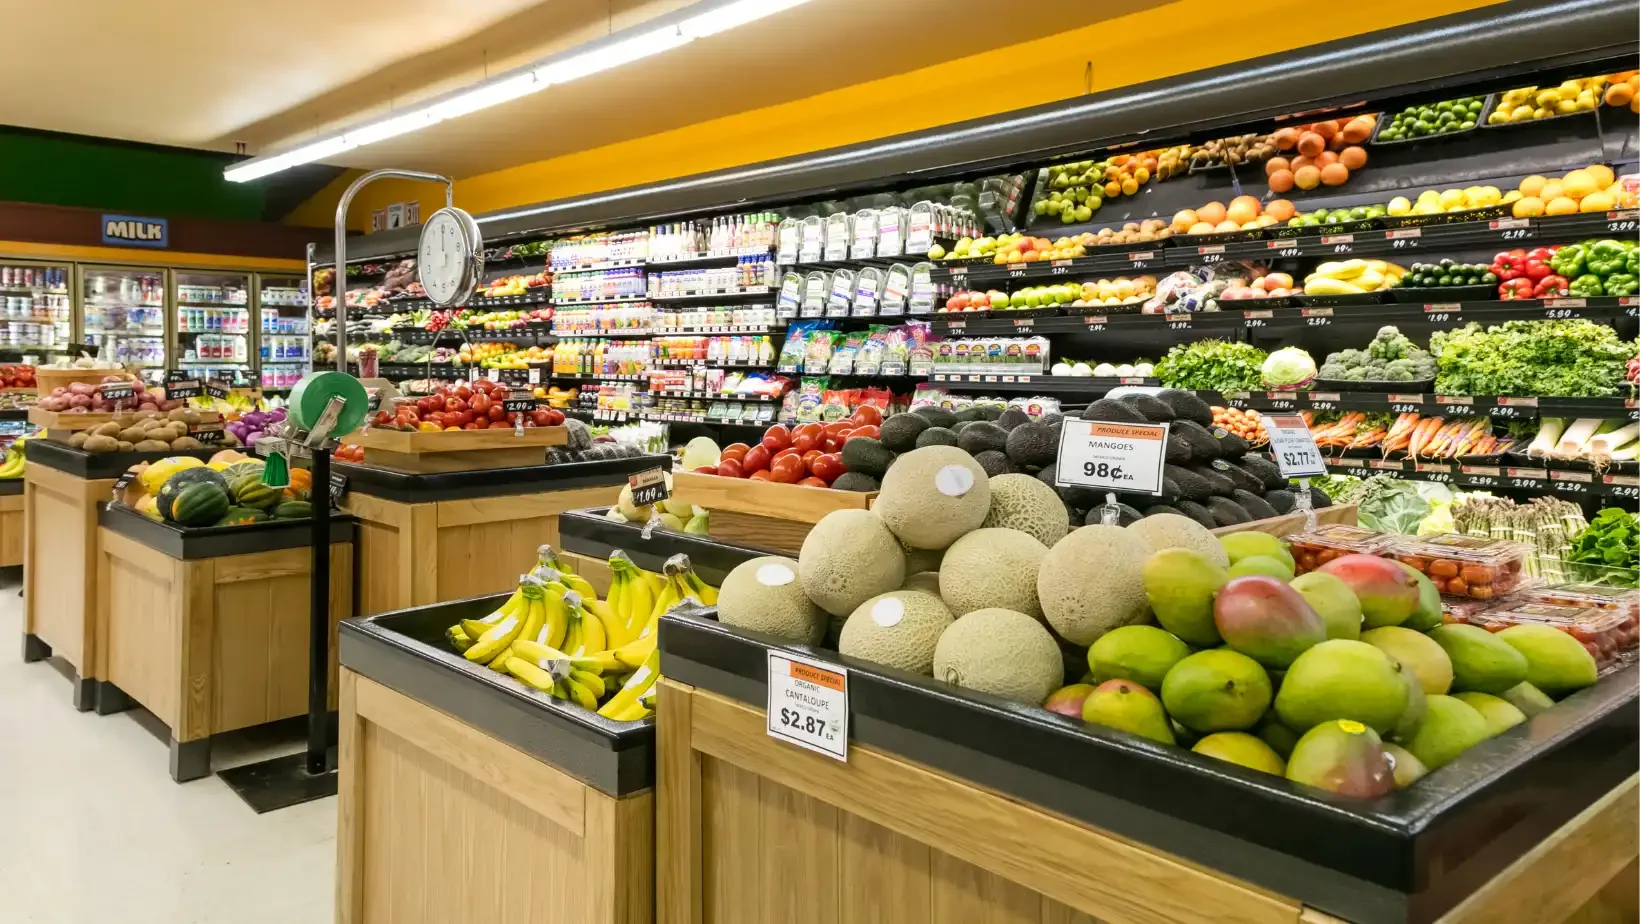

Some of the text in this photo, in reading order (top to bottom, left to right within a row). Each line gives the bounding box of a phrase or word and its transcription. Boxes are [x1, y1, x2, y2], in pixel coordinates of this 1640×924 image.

[106, 220, 162, 240] MILK
[1097, 427, 1129, 435] PRODUCE
[1088, 441, 1134, 451] MANGOES
[1283, 451, 1309, 466] $2.77
[1083, 461, 1123, 482] 98¢
[795, 667, 840, 686] PRODUCE SPECIAL
[795, 679, 820, 693] ORGANIC
[785, 689, 829, 710] CANTALOUPE
[780, 707, 826, 737] $2.87
[825, 732, 834, 741] EA
